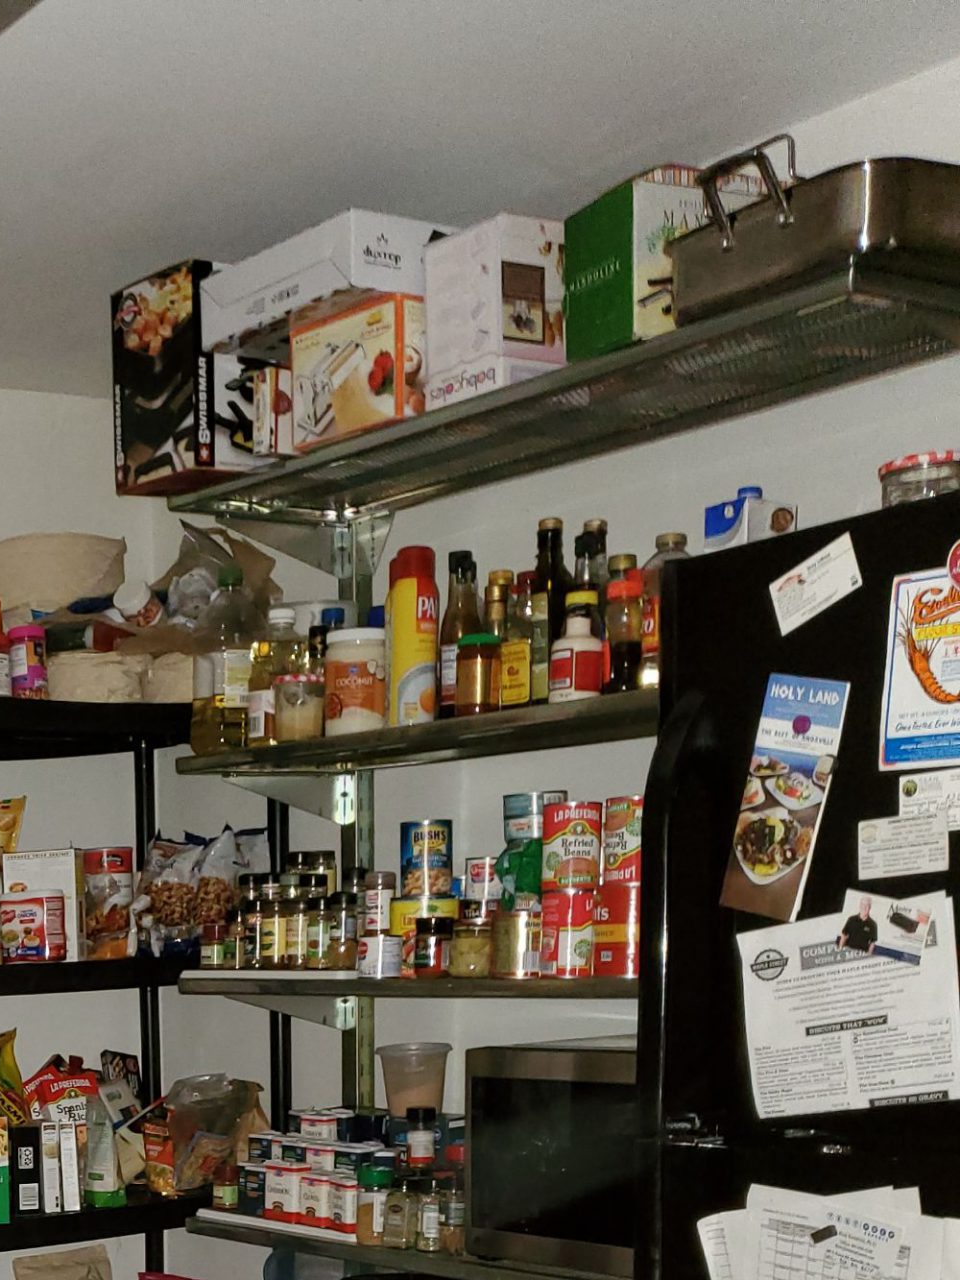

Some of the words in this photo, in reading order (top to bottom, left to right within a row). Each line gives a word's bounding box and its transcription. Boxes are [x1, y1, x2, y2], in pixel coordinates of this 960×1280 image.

[198, 356, 211, 444] SWISSMAR
[770, 683, 805, 701] HOLY
[808, 689, 840, 706] LAND
[413, 828, 447, 843] BUSH'S
[561, 838, 595, 848] Refried
[563, 848, 592, 857] Beans
[842, 1020, 863, 1031] THAT
